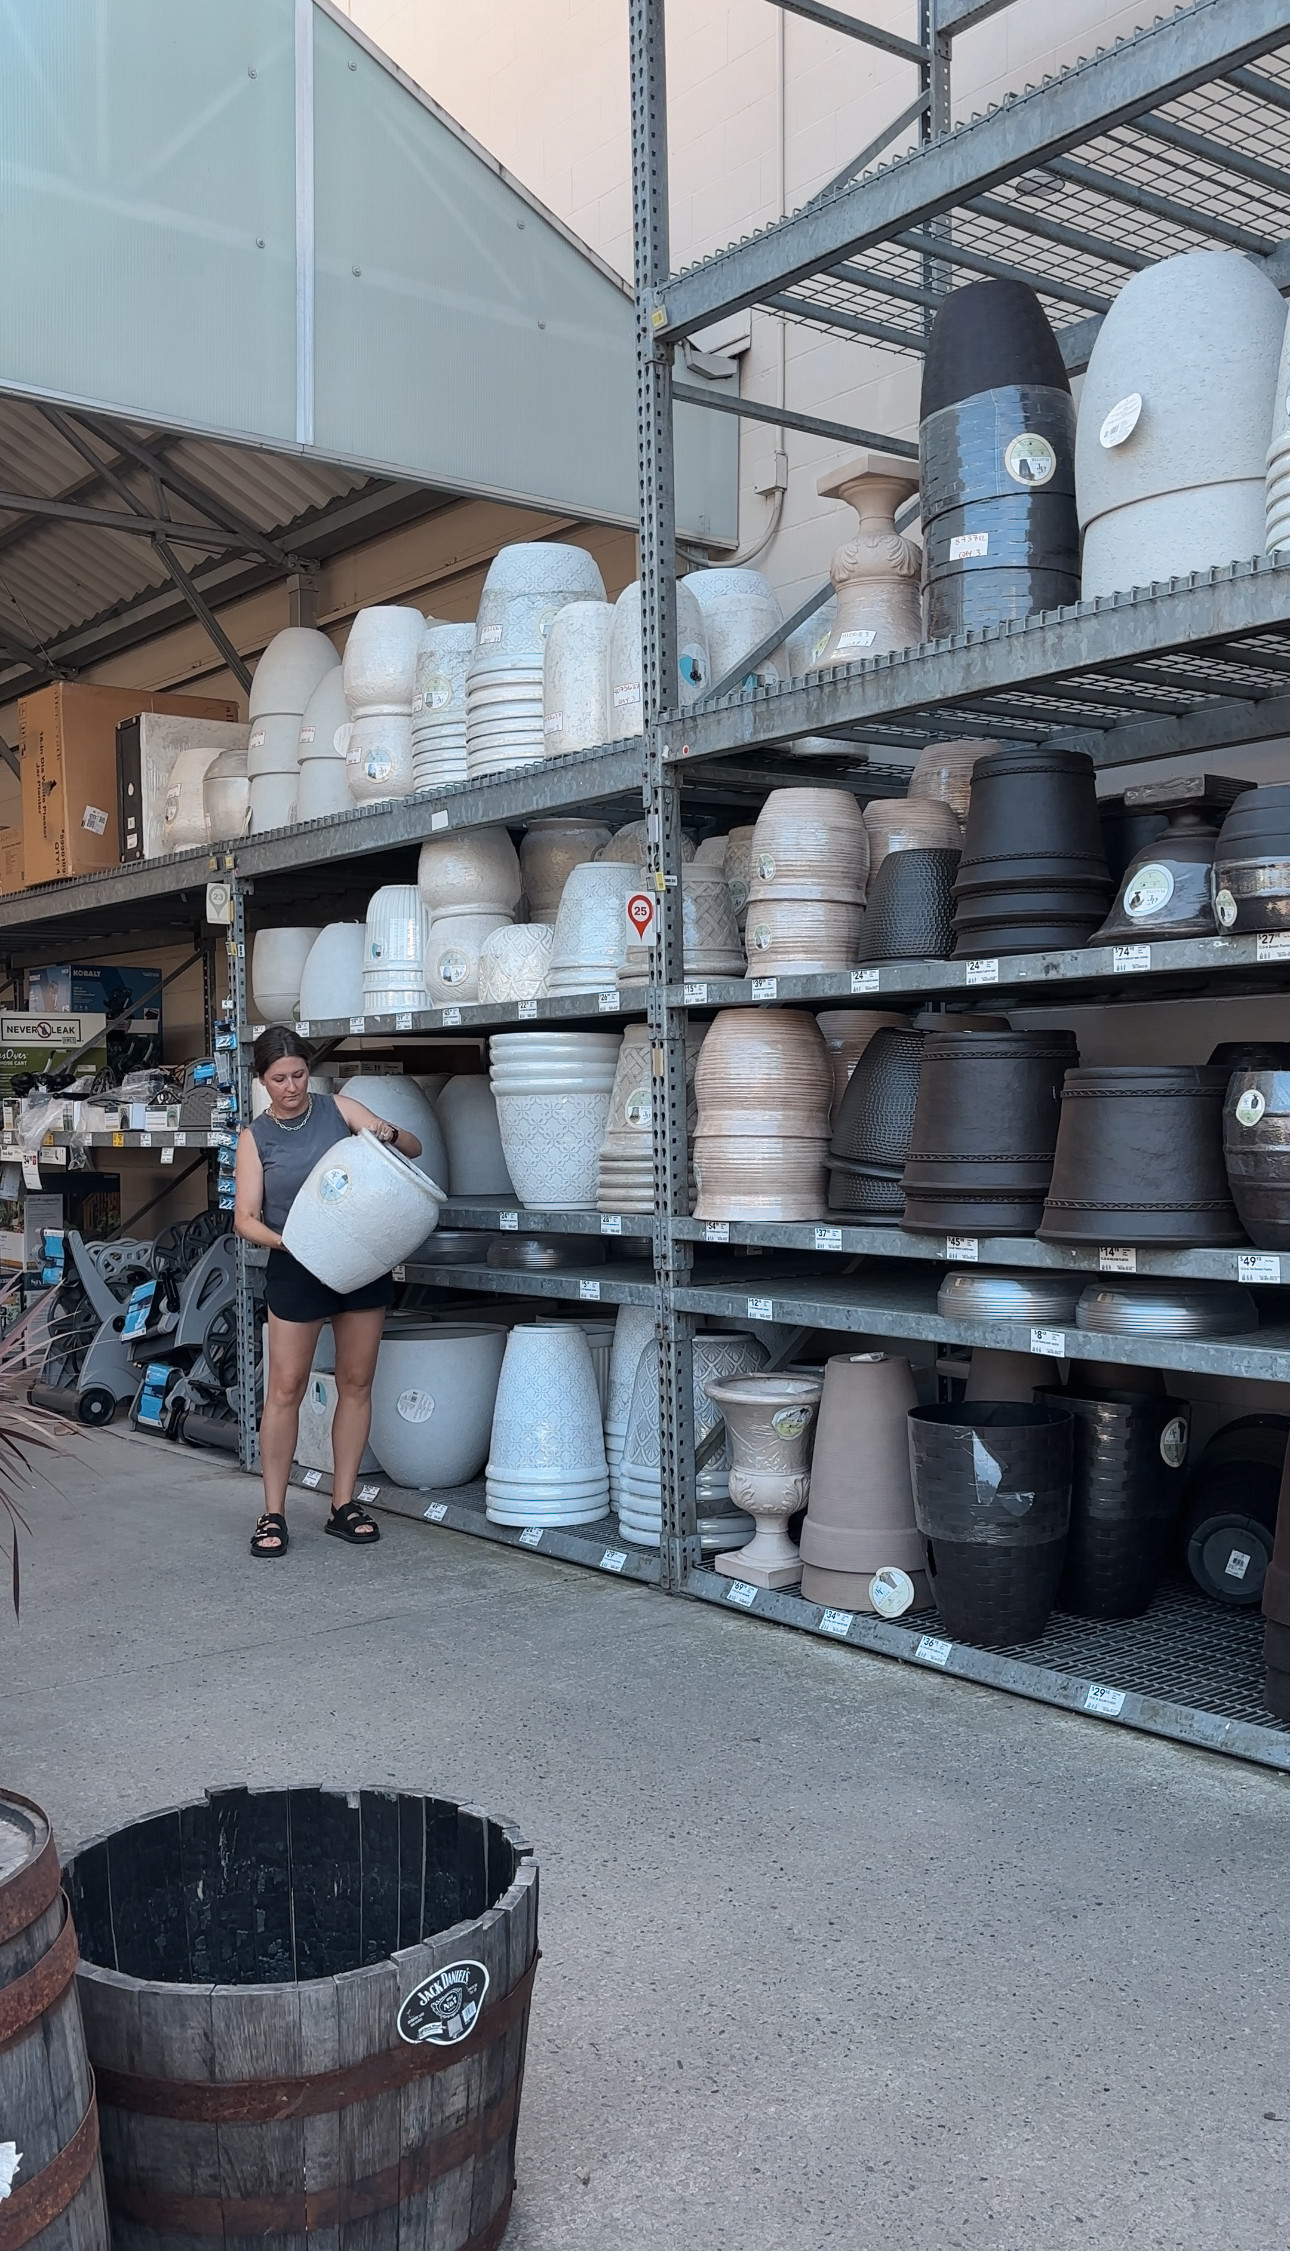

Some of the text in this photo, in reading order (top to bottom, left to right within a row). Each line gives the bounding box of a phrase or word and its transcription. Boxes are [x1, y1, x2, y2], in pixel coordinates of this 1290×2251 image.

[212, 893, 224, 901] 23
[634, 906, 647, 916] 25
[6, 1026, 75, 1034] NEVER LEAK
[1240, 1257, 1256, 1266] $49
[1091, 1686, 1106, 1697] $29
[417, 1981, 443, 2006] JACK
[441, 1967, 470, 1989] DANIEL'S
